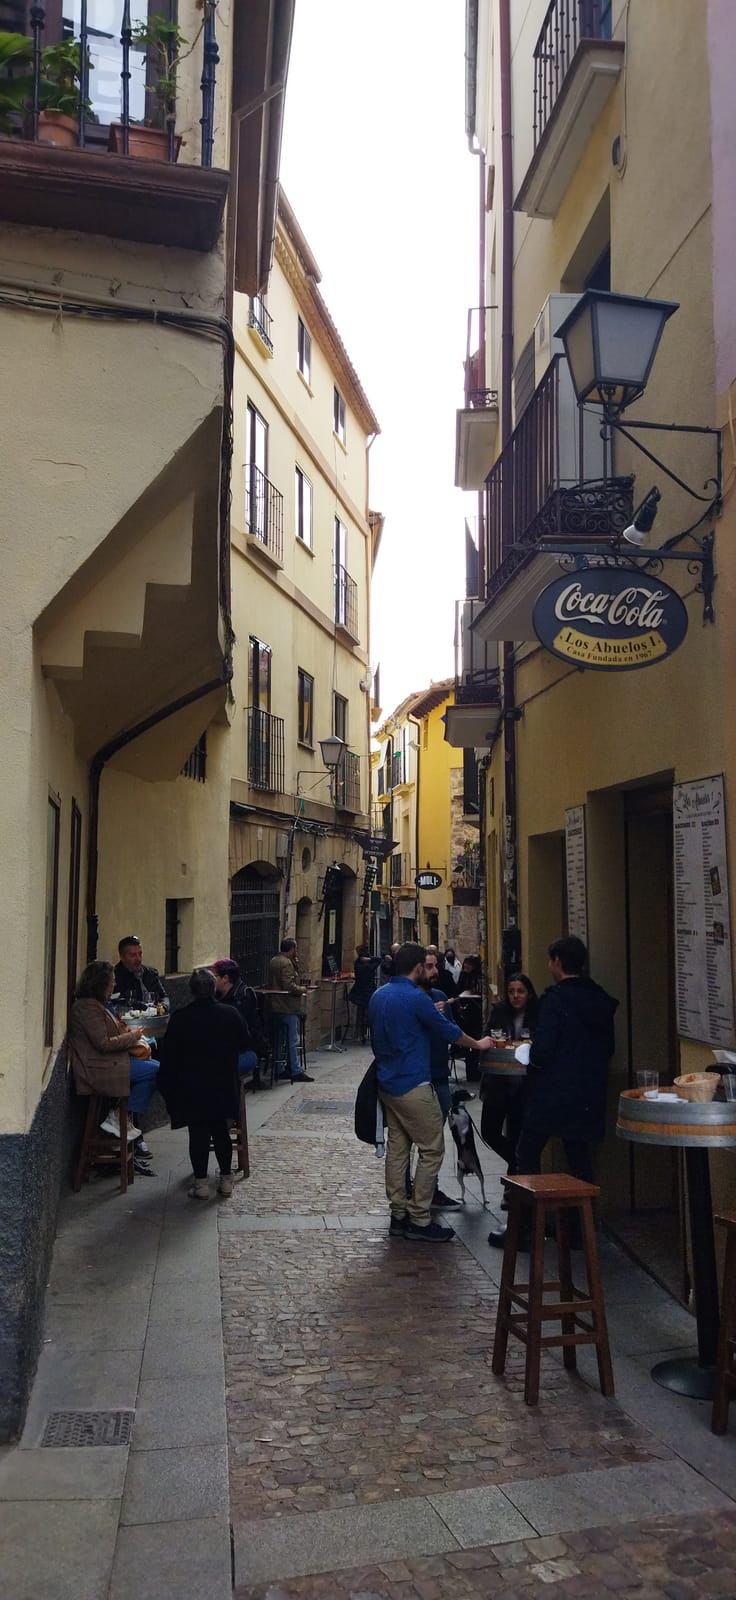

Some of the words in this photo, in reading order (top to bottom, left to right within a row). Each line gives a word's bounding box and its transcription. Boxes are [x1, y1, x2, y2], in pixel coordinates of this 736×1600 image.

[554, 582, 671, 629] Coca-Cola
[565, 632, 589, 649] Los
[592, 640, 648, 654] Abuelos
[566, 646, 585, 657] Casa
[587, 652, 622, 663] Fundada
[635, 650, 653, 660] 1967
